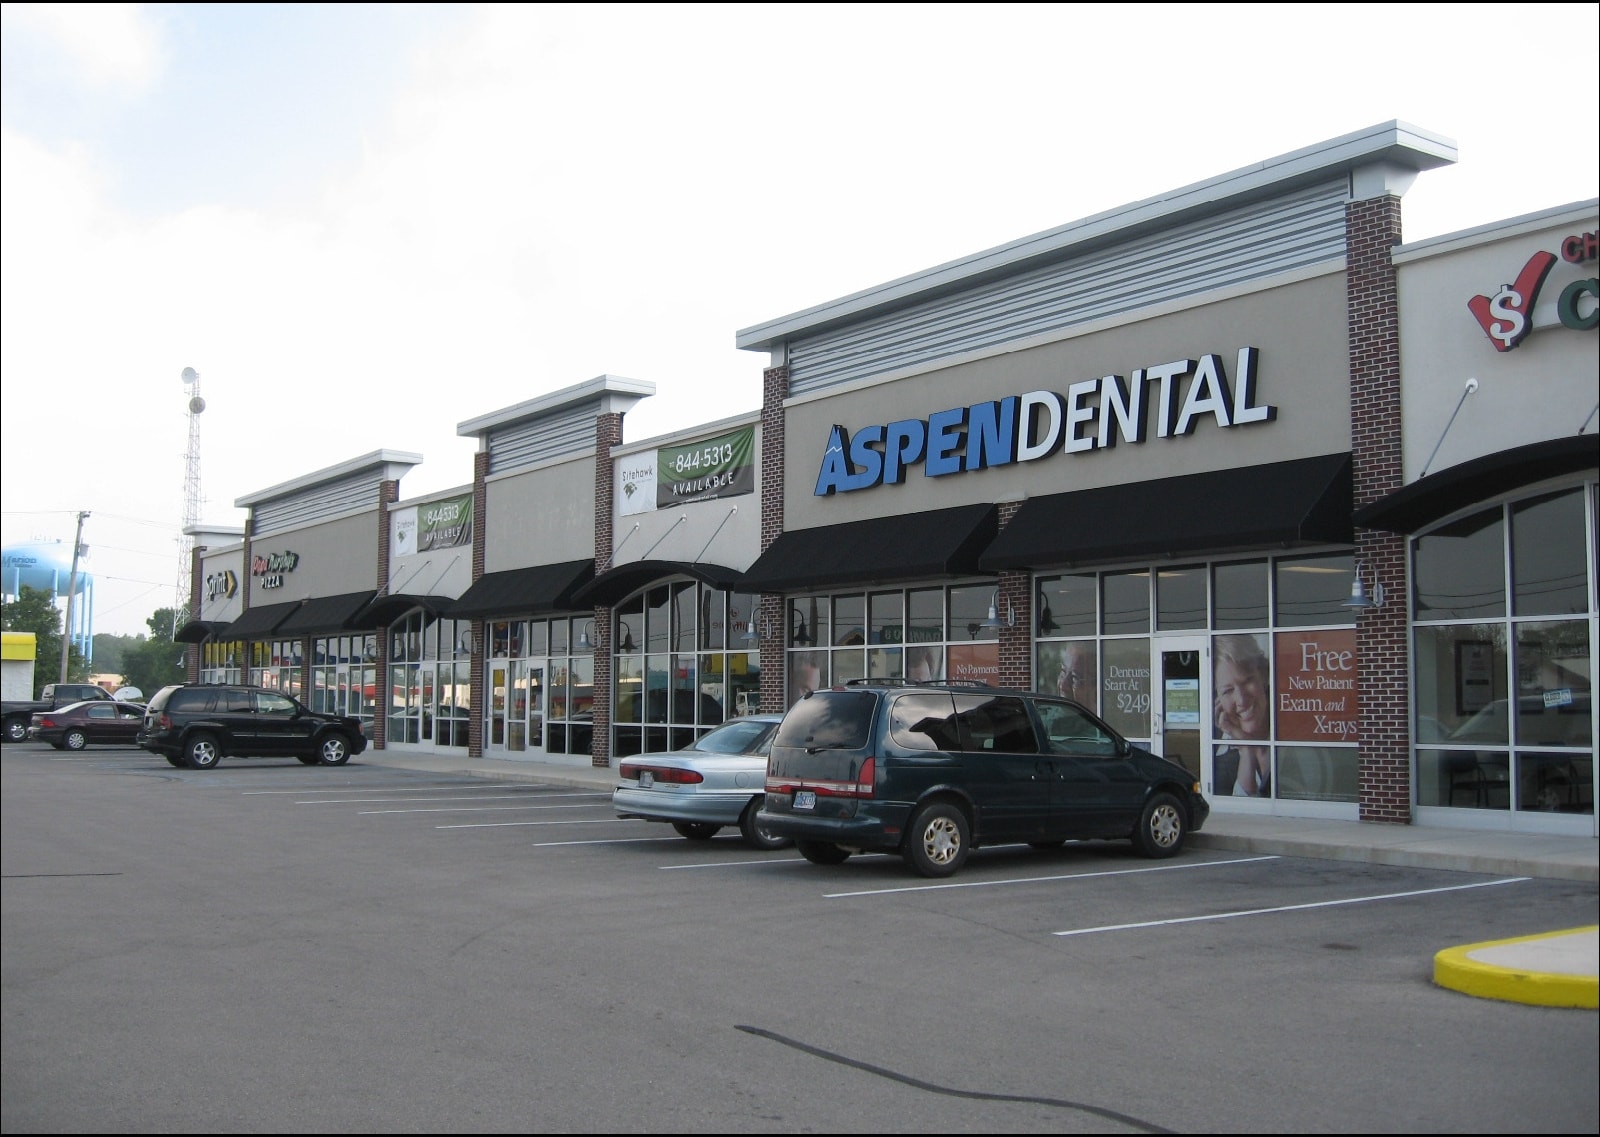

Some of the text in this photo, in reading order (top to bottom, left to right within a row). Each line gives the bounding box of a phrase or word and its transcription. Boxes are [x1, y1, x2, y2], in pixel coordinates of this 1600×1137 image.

[675, 443, 733, 473] 844-5313
[622, 465, 653, 482] Sitehawk
[672, 472, 734, 496] AVAILABLE
[205, 571, 228, 601] Sprint
[260, 575, 283, 589] PIZZA
[1299, 642, 1353, 672] Free
[956, 664, 999, 677] No Payments
[1109, 665, 1150, 679] Dentures
[1104, 678, 1139, 691] Start At
[1288, 674, 1355, 690] New Patient
[1117, 692, 1150, 714] $249
[1279, 693, 1346, 712] Exam and
[1312, 715, 1358, 740] X-rays
